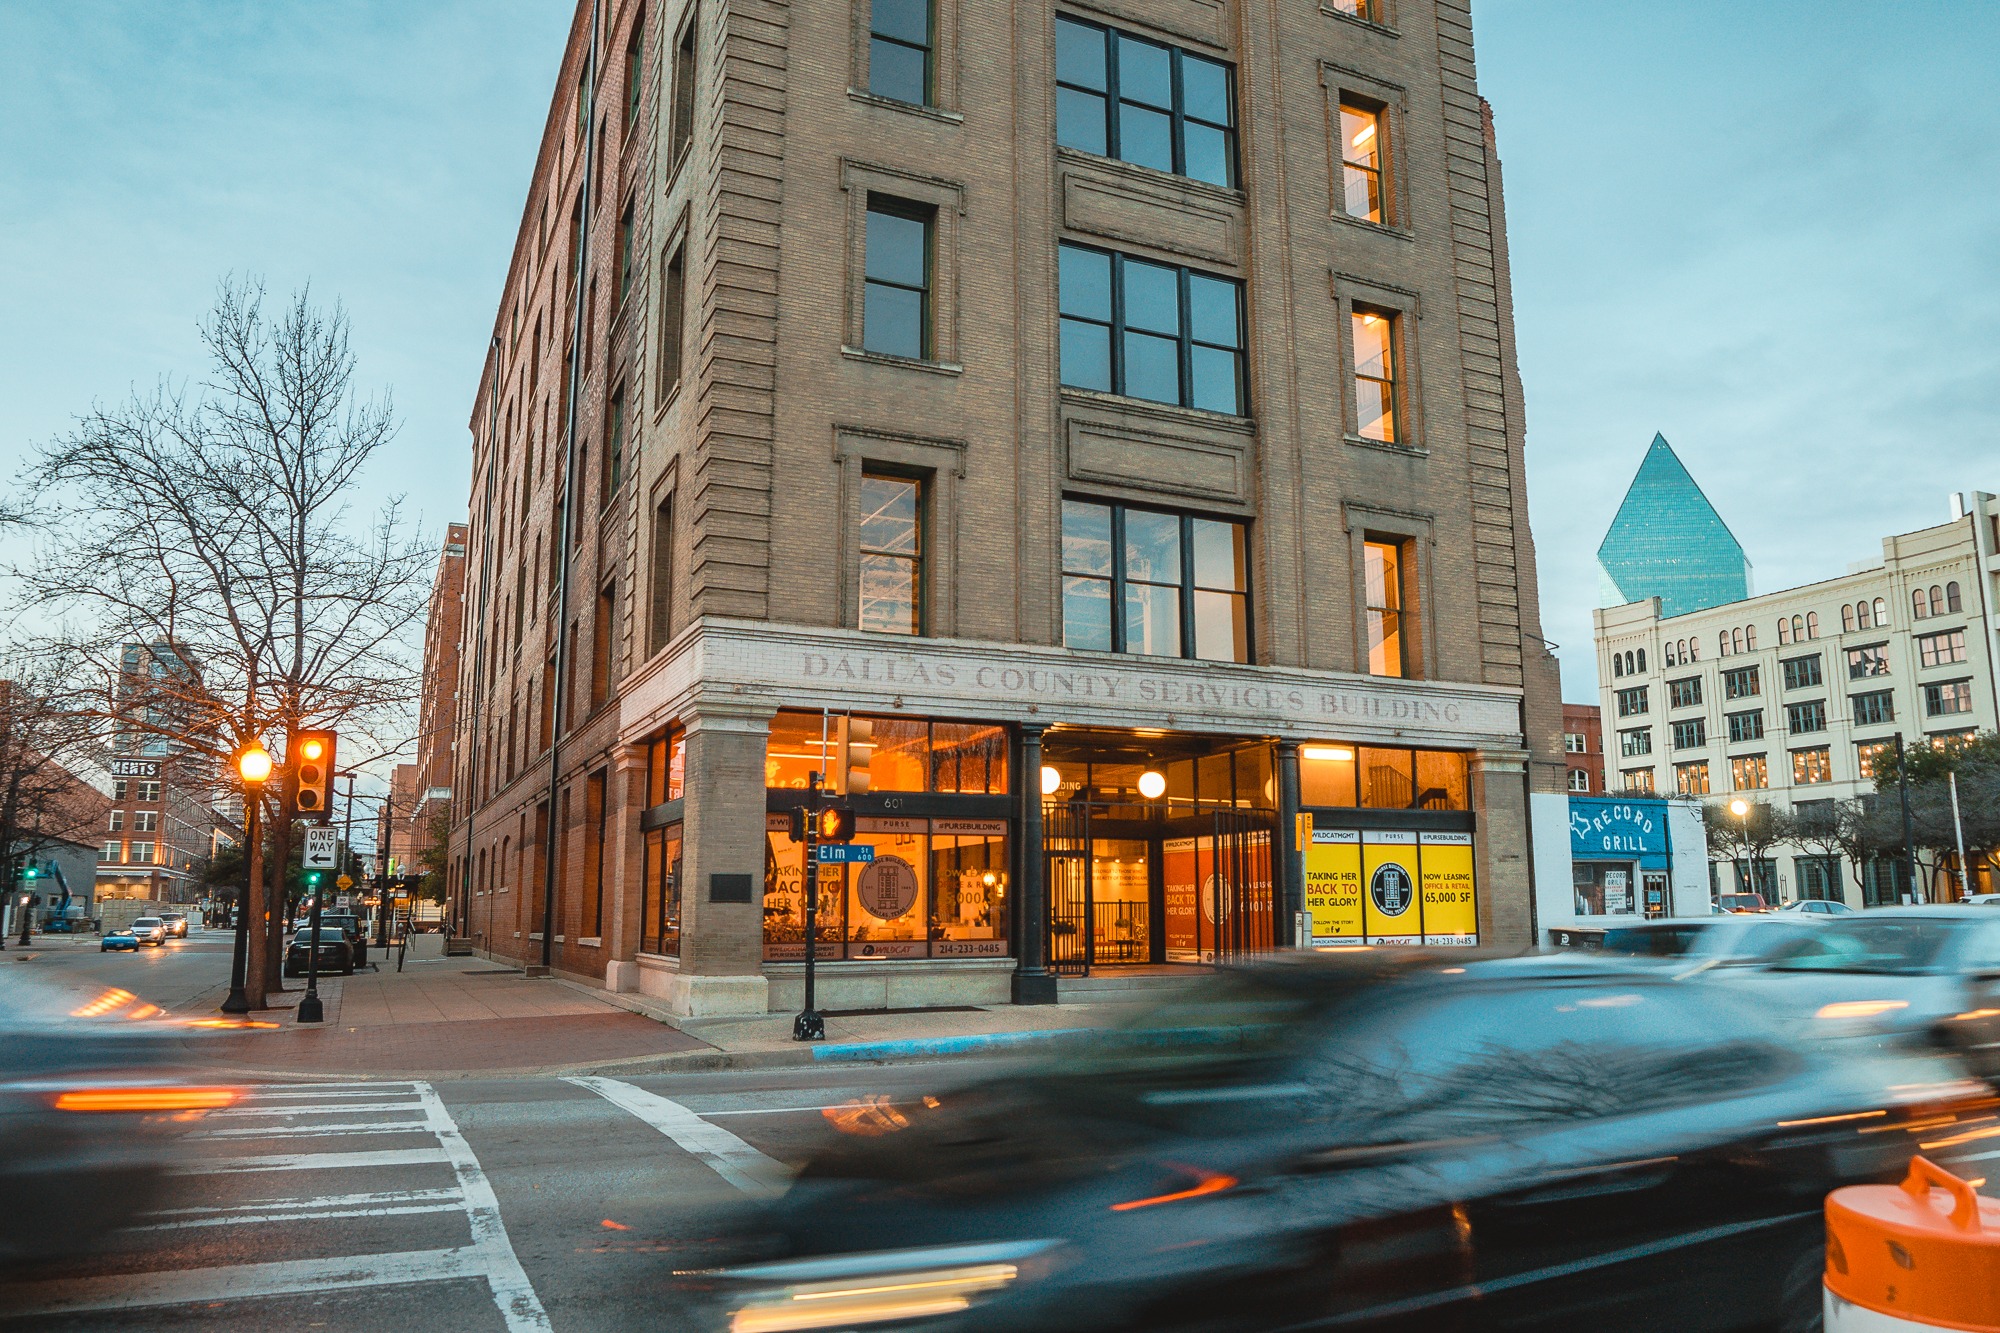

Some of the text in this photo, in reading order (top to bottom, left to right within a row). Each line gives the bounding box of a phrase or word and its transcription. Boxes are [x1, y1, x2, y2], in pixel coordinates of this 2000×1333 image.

[803, 653, 1461, 723] DALLAS COUNTY SERVICES BUILDING
[884, 798, 903, 808] 601
[1593, 805, 1652, 833] RECORD
[939, 822, 1001, 831] #PURSEBUILDING
[310, 830, 334, 840] ONE
[309, 842, 334, 852] WAY
[1603, 836, 1647, 851] GRILL
[820, 846, 845, 859] Elm
[1307, 872, 1357, 880] TAKING HER
[1185, 884, 1196, 892] HER
[1307, 883, 1358, 894] BACK TO
[767, 898, 791, 908] HER
[1166, 894, 1196, 904] BACK TO
[1307, 898, 1358, 906] HER GLORY
[1425, 892, 1471, 904] 65,000 SF
[1167, 907, 1196, 915] HER GLORY
[1430, 937, 1472, 945] 214-233-0485
[874, 945, 914, 954] WILDCAT
[939, 944, 1000, 954] 214-233-0485
